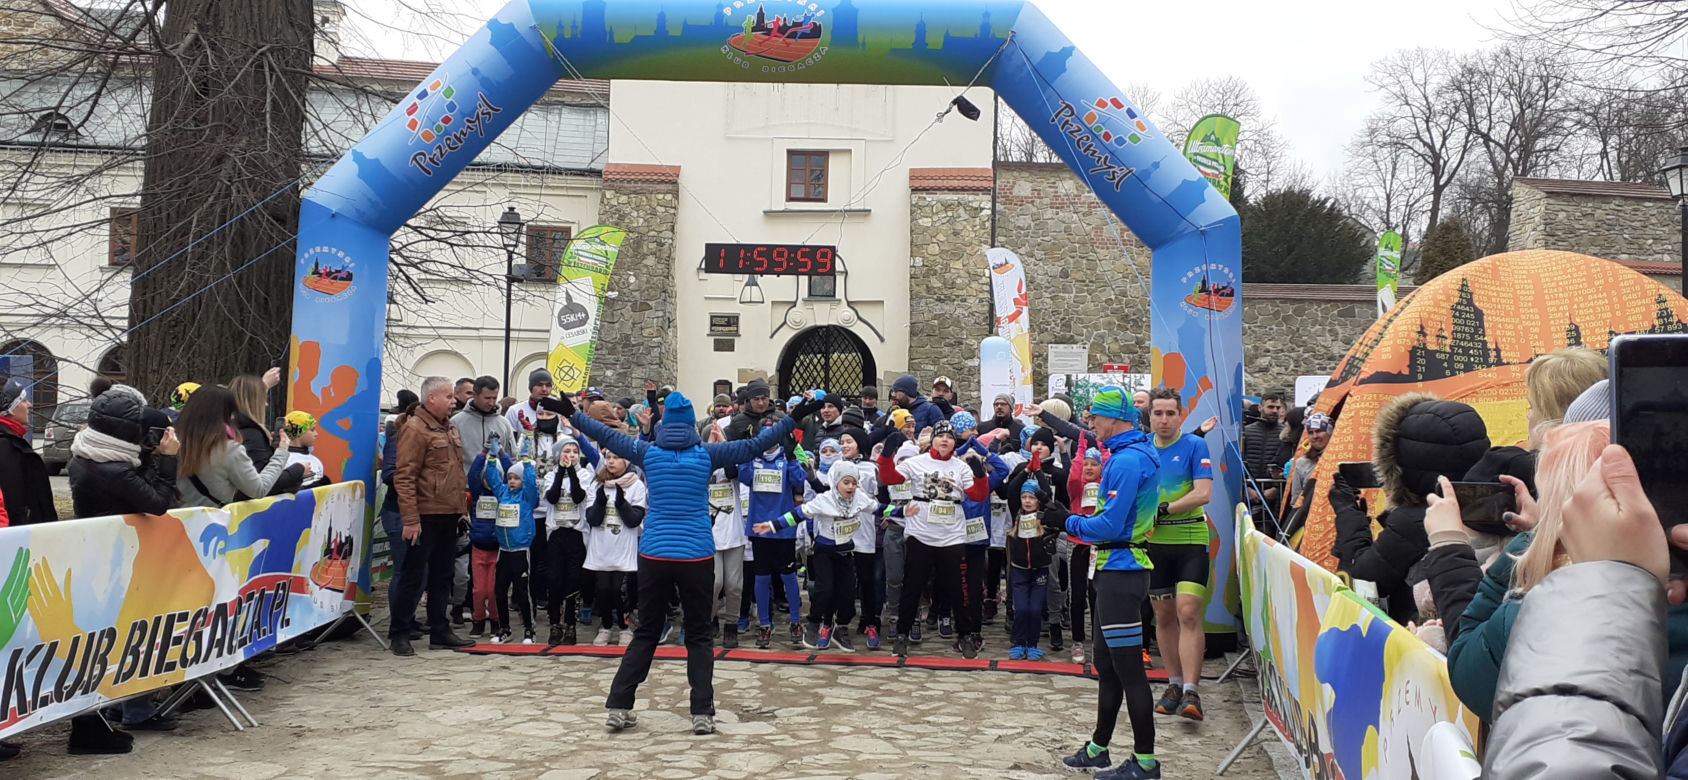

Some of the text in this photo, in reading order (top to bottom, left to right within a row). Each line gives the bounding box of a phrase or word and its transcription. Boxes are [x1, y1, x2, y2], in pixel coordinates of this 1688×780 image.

[409, 91, 503, 176] Przemyśl
[1050, 100, 1136, 192] Przemyśl
[719, 247, 833, 273] 11:59:59
[1667, 324, 1683, 332] 893
[0, 626, 118, 722] KLUB
[112, 577, 292, 686] BIEGACZA.PL
